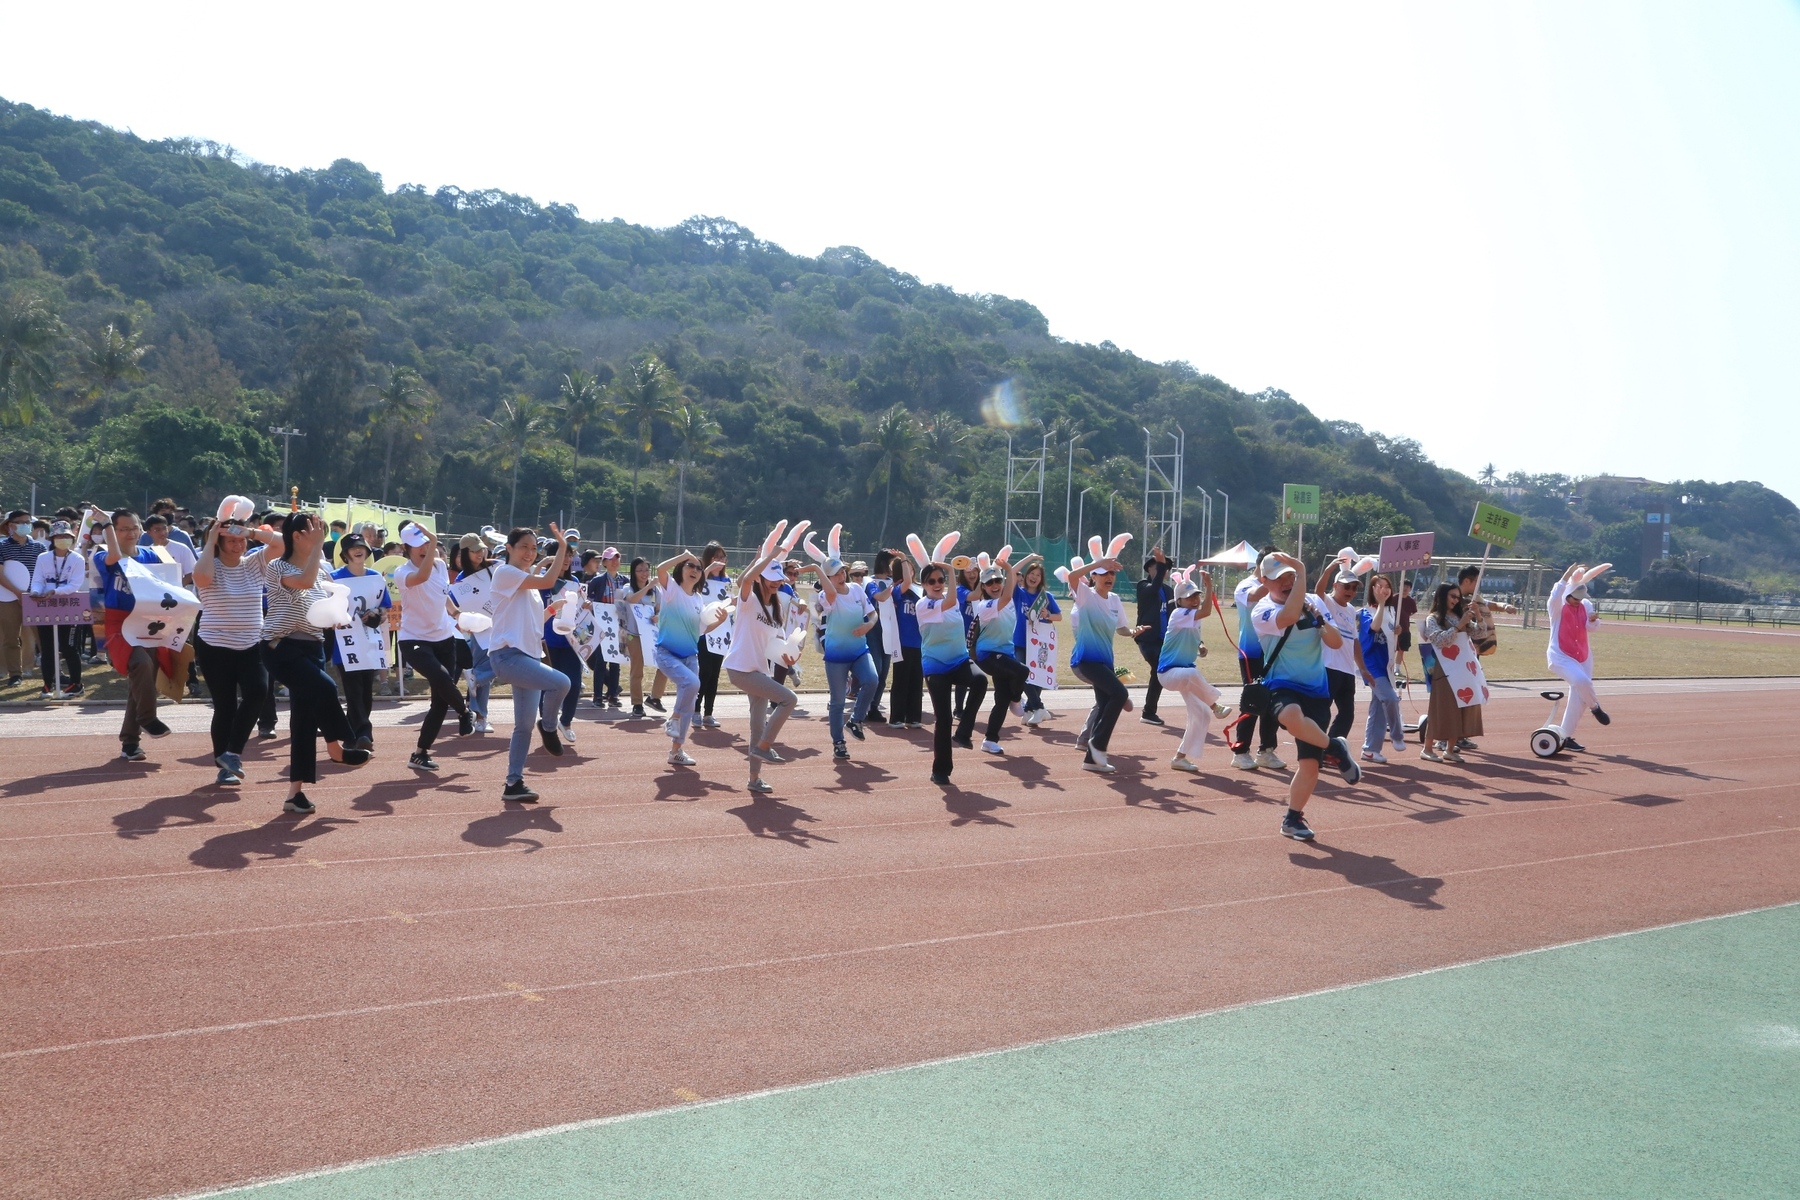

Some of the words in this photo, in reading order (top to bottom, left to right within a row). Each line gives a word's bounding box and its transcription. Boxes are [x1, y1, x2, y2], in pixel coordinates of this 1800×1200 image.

[1485, 511, 1510, 530] 主計室
[1395, 540, 1420, 552] 人事室
[1049, 631, 1055, 641] Q
[1046, 675, 1053, 686] Q
